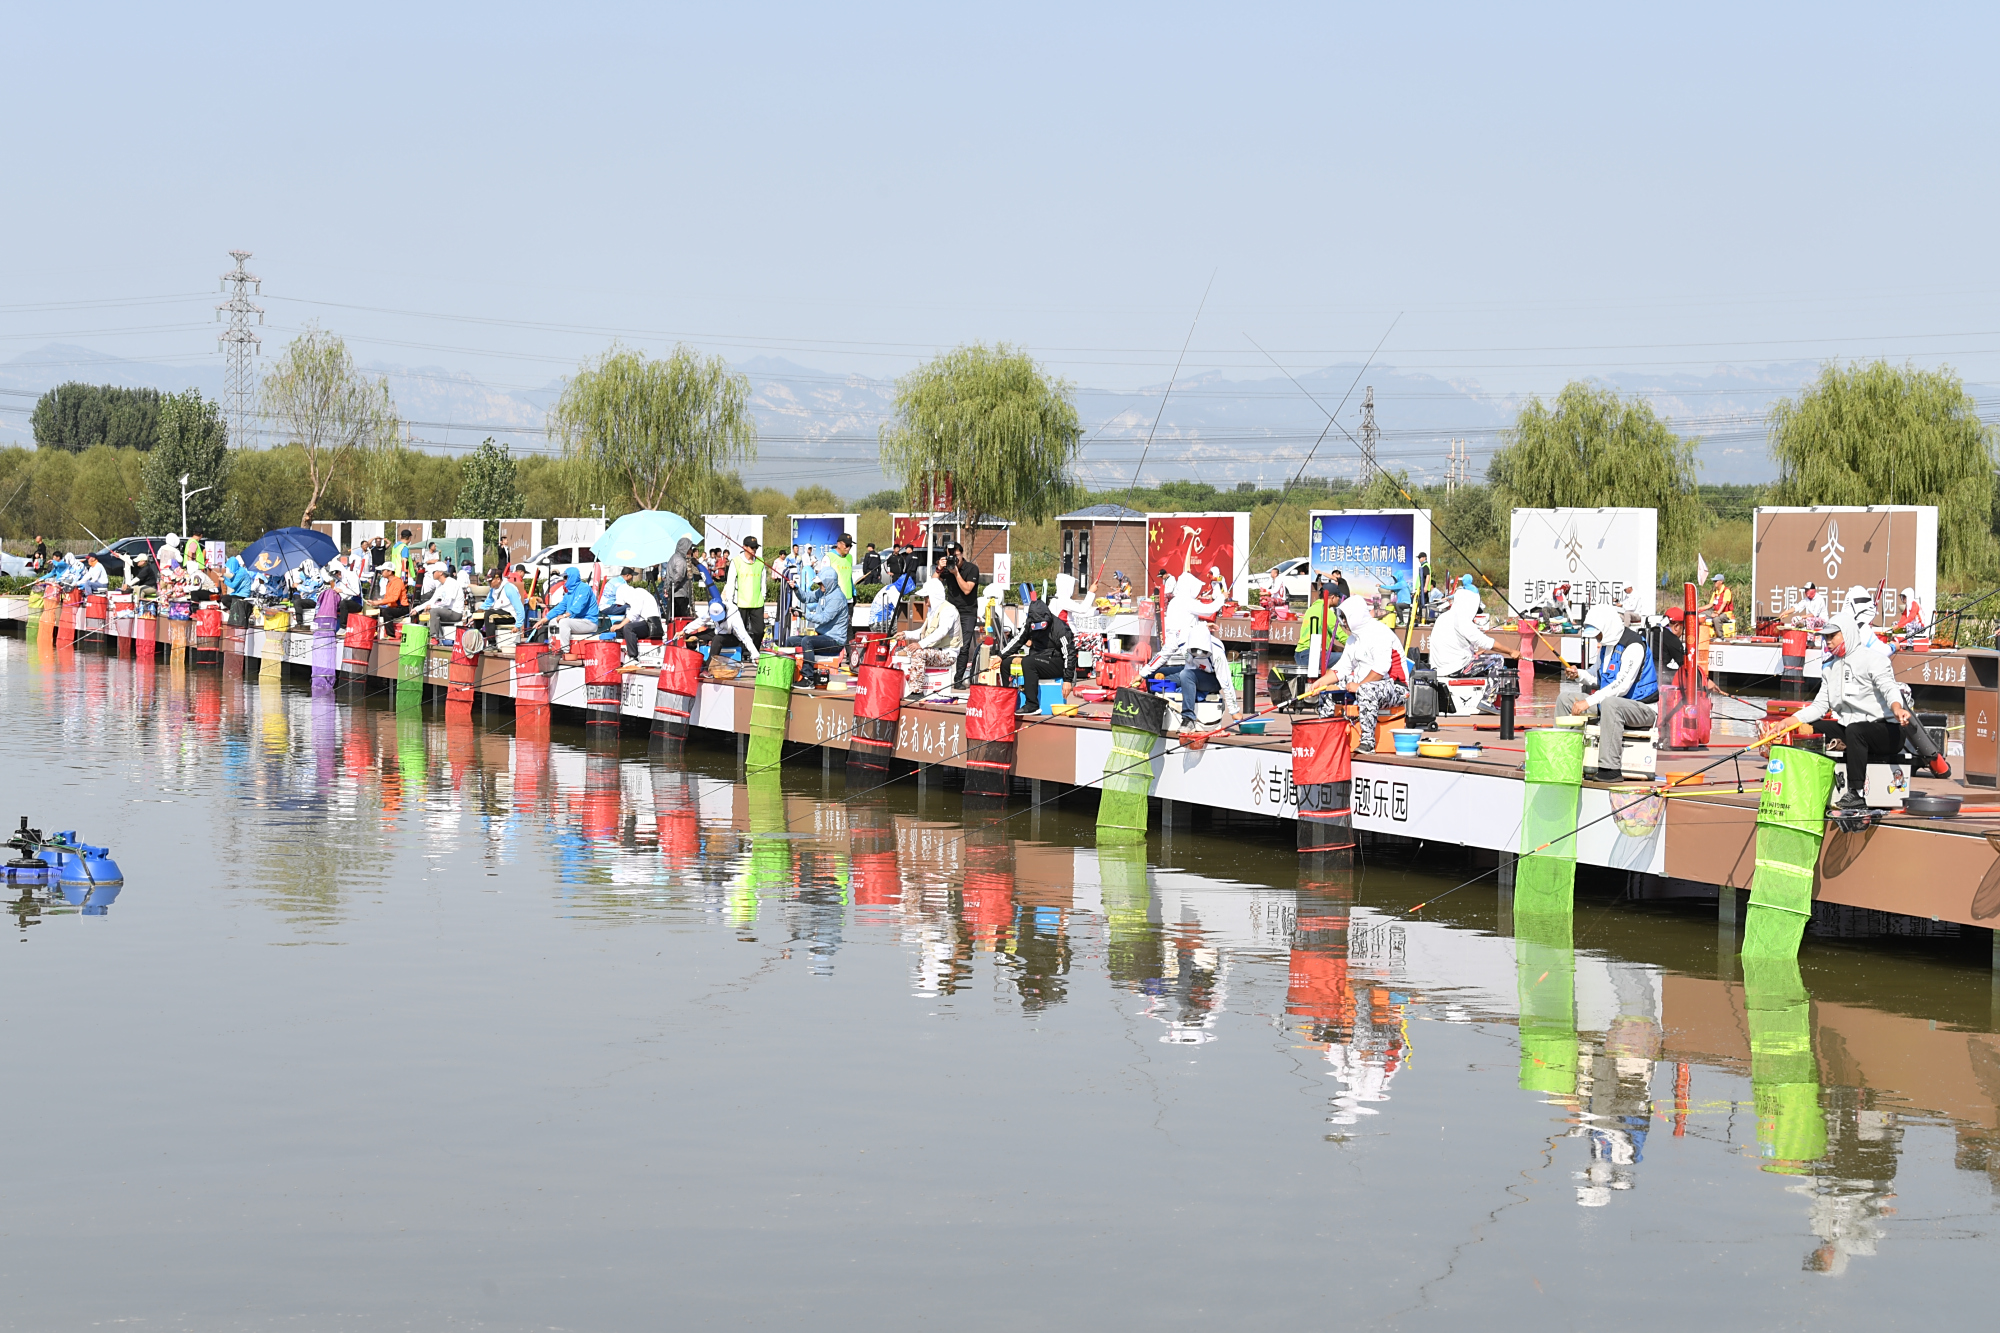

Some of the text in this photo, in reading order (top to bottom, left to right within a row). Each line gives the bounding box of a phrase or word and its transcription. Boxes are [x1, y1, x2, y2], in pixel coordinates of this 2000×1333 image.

[1320, 545, 1406, 563] 打造绿色生态休闲小镇
[997, 561, 1006, 583] 八区
